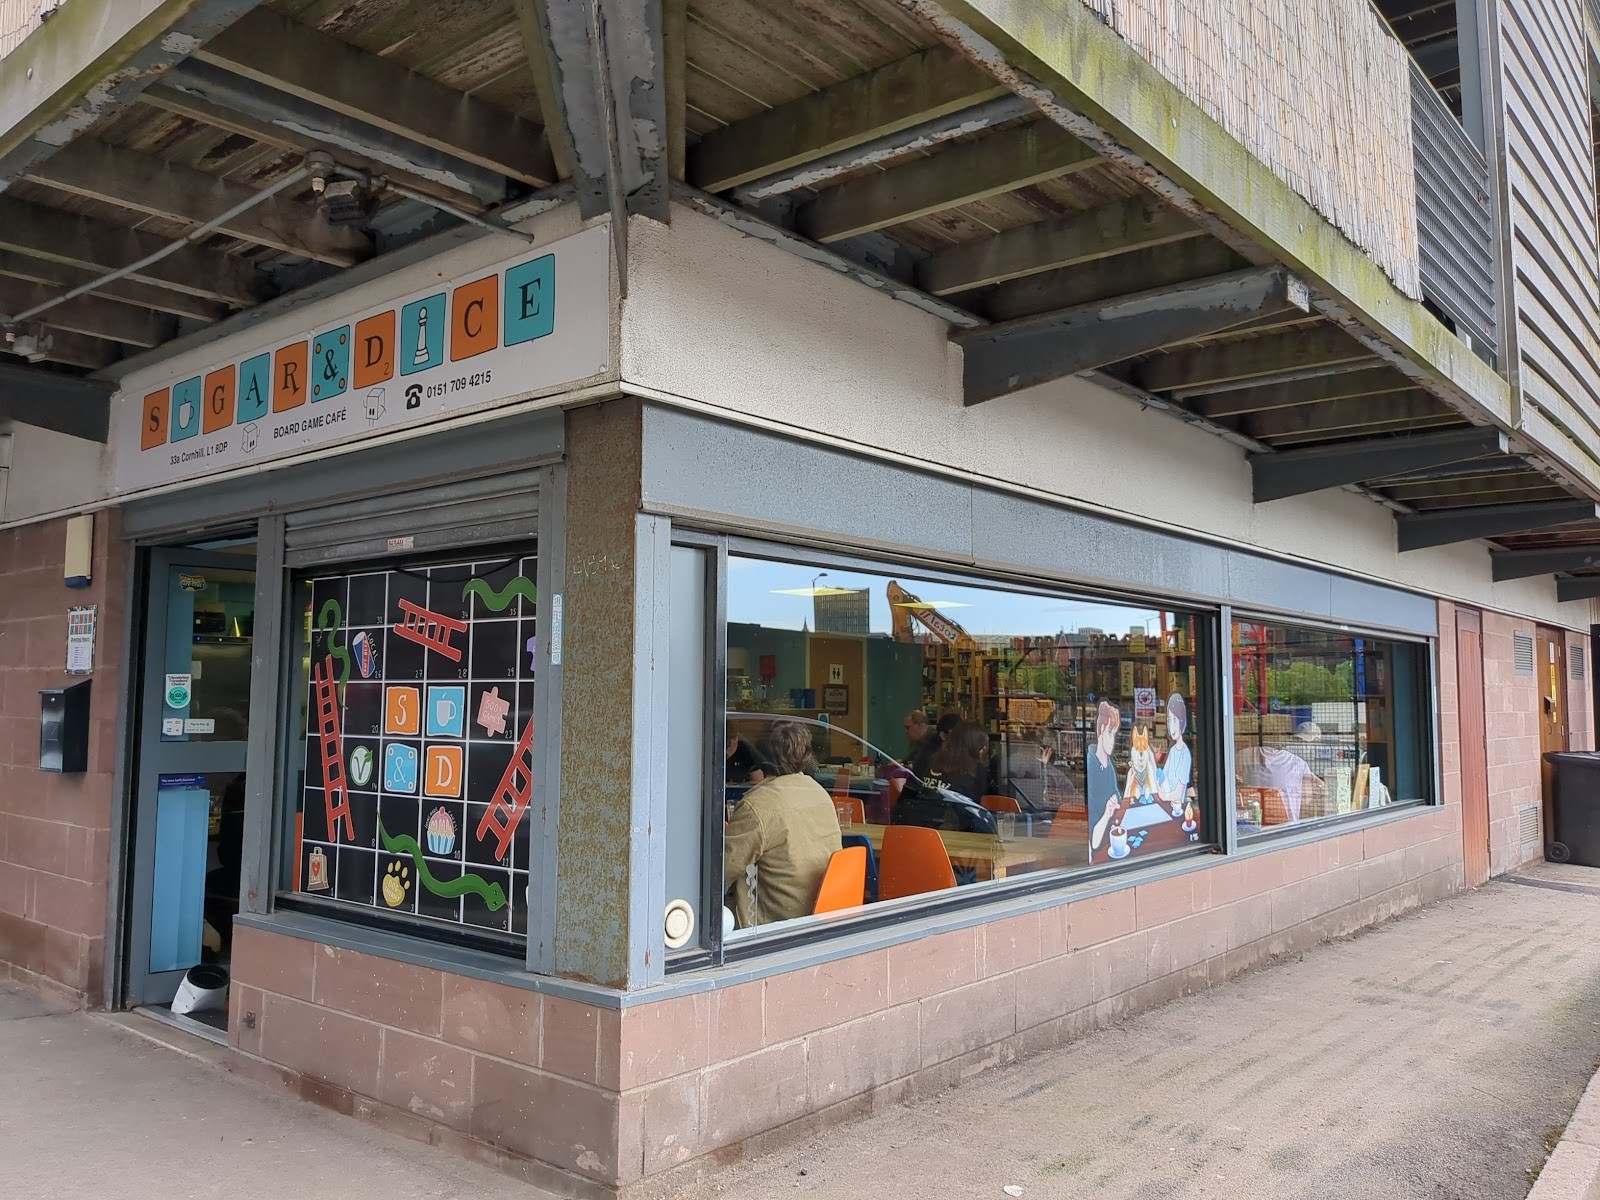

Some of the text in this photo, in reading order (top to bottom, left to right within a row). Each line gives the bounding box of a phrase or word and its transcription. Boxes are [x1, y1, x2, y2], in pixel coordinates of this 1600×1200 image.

[426, 370, 492, 398] 0151 709 4215
[273, 407, 347, 439] BOARD GAME CAFÉ
[367, 632, 379, 661] LOCAL
[374, 669, 381, 679] 26
[415, 669, 423, 678] 27
[458, 668, 467, 679] 28
[394, 694, 407, 726] S
[371, 725, 378, 734] 20
[505, 729, 512, 739] 23
[393, 755, 452, 787] & D
[371, 838, 375, 847] 8
[410, 904, 414, 912] 3
[453, 909, 458, 919] 4
[502, 920, 507, 929] 5
